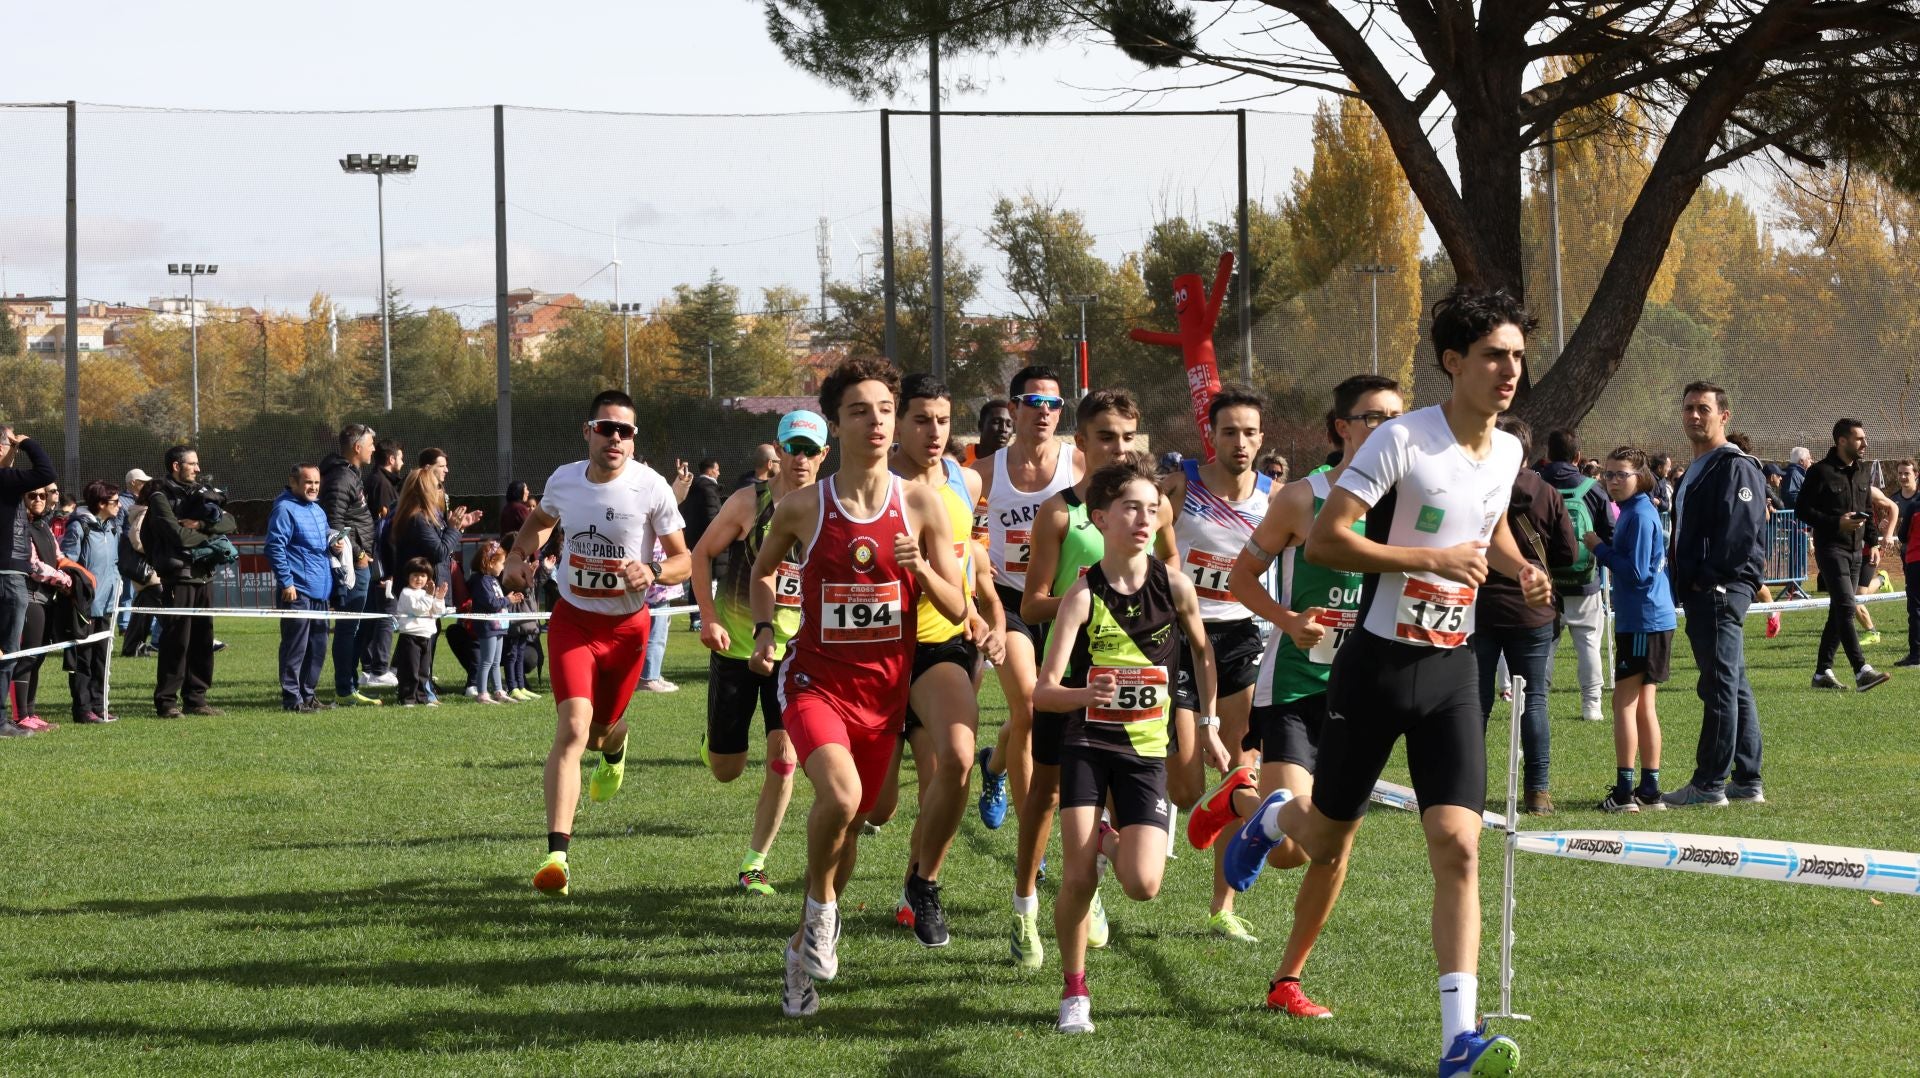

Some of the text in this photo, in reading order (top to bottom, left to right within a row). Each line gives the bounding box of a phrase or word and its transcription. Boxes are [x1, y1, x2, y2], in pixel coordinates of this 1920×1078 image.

[790, 420, 817, 430] HOKA
[889, 509, 898, 517] BA
[592, 543, 626, 558] PABLO
[583, 564, 607, 572] Palencia
[1207, 562, 1232, 571] Palencia
[1211, 555, 1232, 564] CROSS
[575, 569, 618, 589] 170
[776, 576, 801, 596] 15
[833, 603, 892, 627] 194
[1412, 601, 1464, 632] 175
[1104, 686, 1158, 709] 58
[1677, 844, 1740, 867] plaspisa
[1797, 854, 1865, 880] plaspisa
